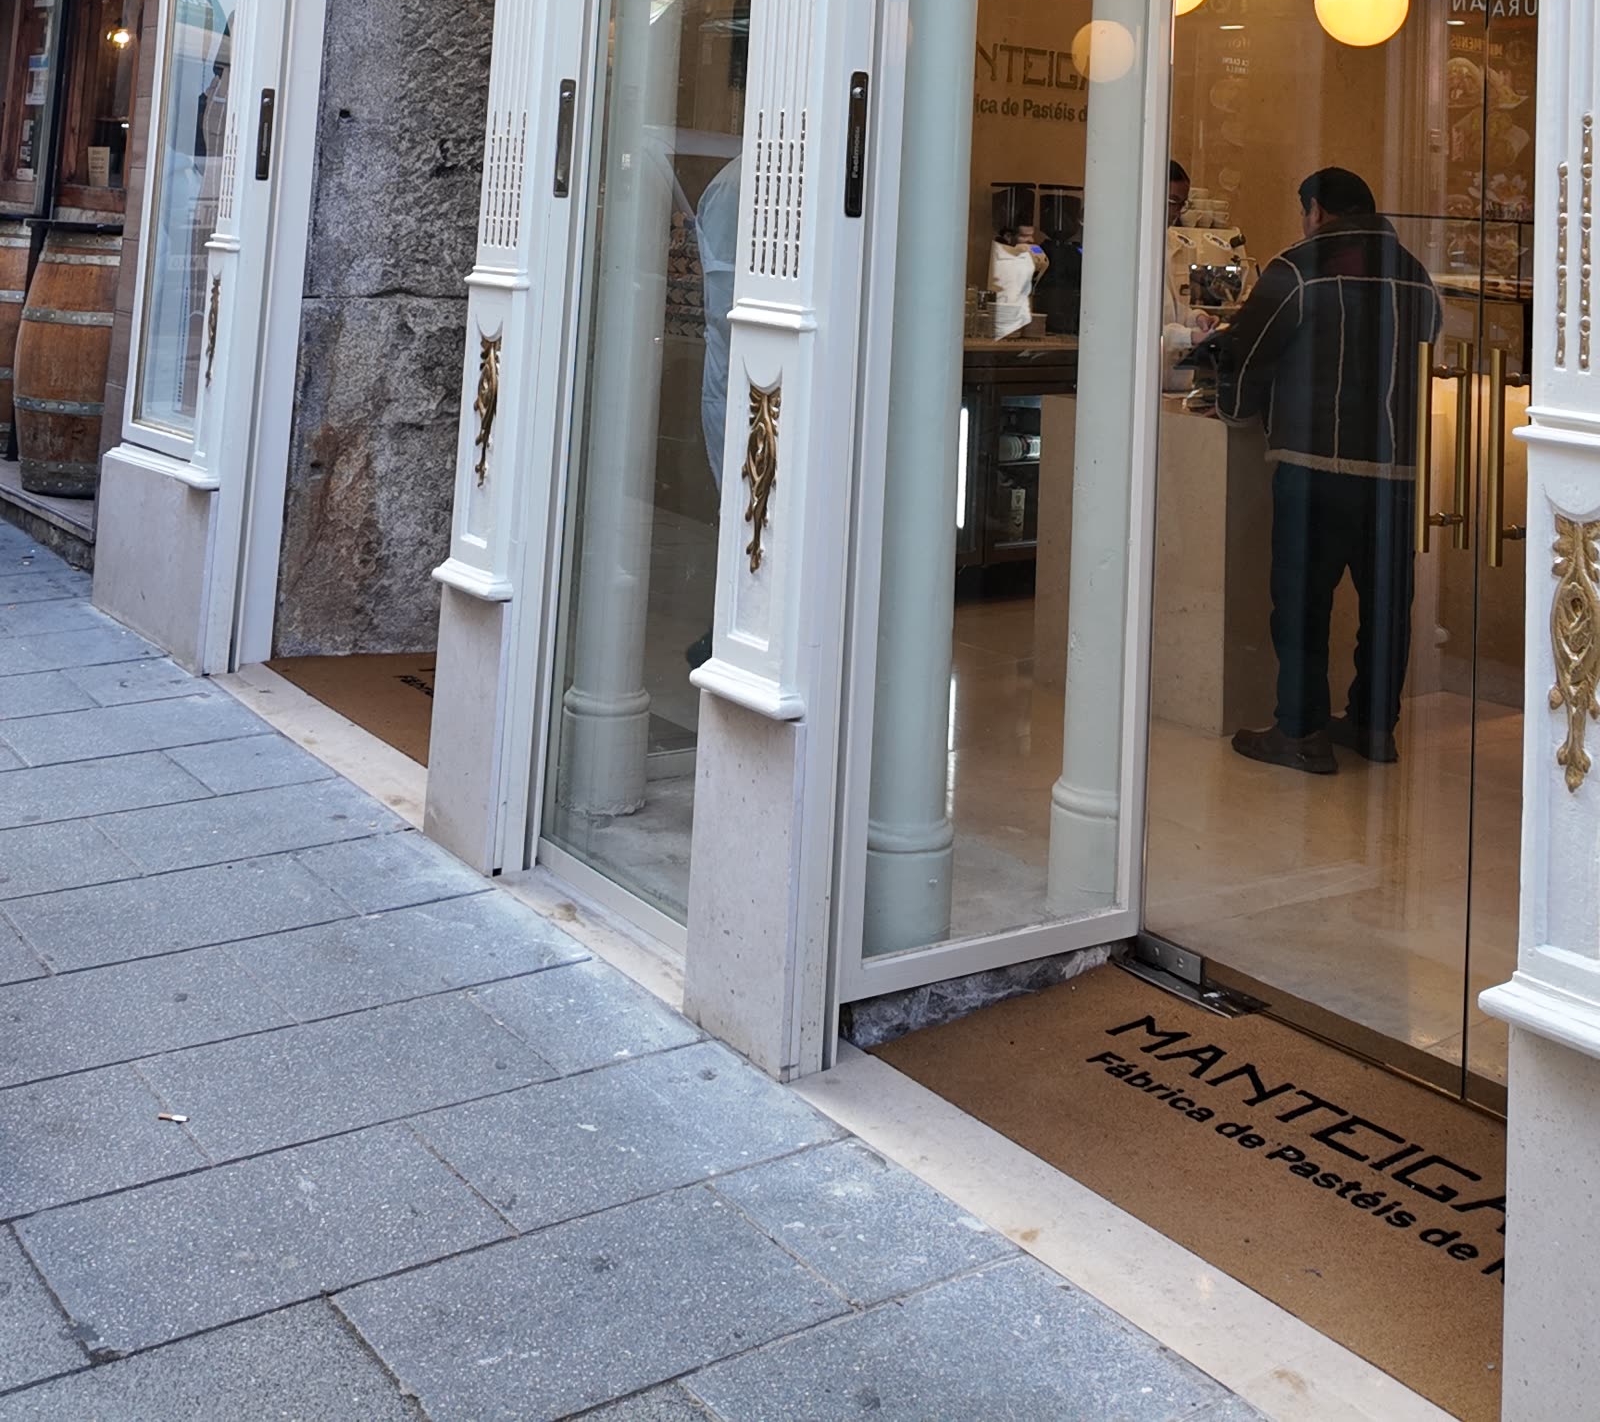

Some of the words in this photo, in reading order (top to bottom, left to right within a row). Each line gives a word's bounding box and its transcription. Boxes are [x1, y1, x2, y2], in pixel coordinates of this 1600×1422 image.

[975, 94, 998, 115] ica
[1001, 97, 1019, 117] de
[1023, 99, 1075, 123] Pastéis
[1086, 1051, 1215, 1123] Fábrica
[1215, 1122, 1266, 1149] de
[1265, 1144, 1417, 1228] Pastéis
[1419, 1228, 1479, 1261] de
